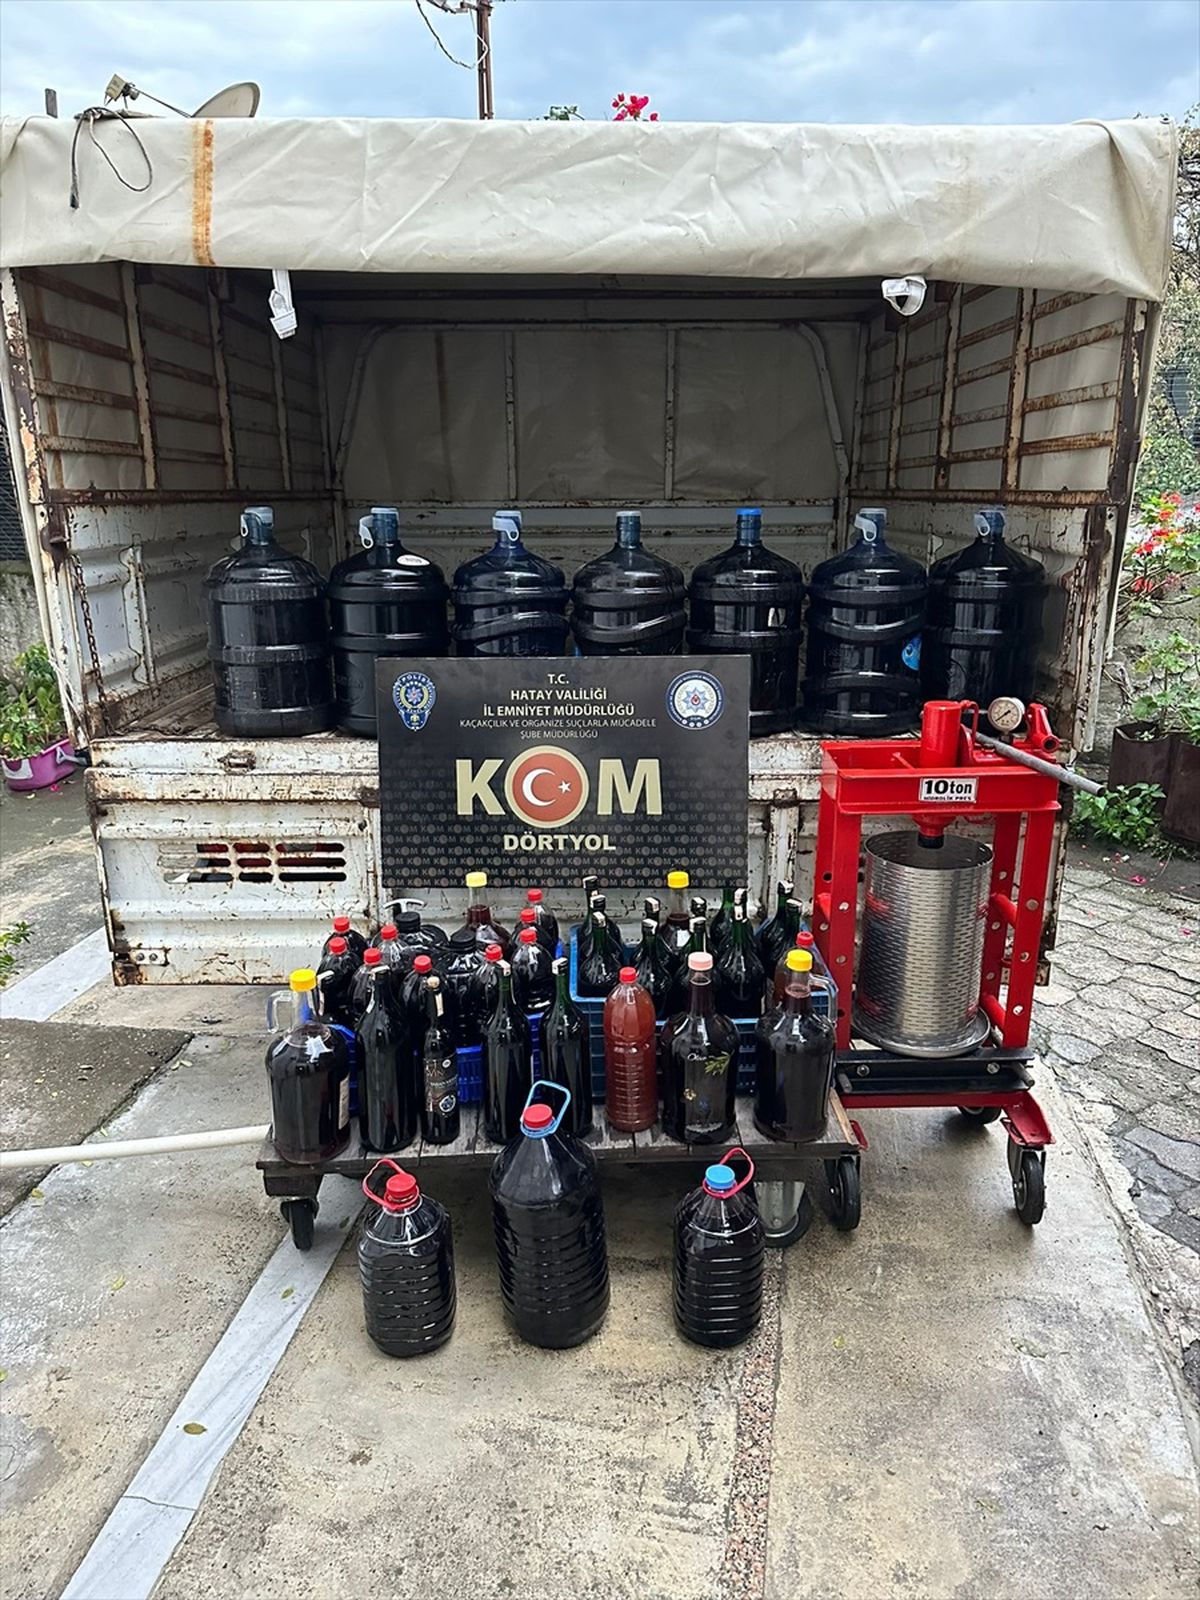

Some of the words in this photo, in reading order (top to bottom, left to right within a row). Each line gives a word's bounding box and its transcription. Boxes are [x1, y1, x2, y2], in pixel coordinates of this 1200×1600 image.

[547, 674, 570, 684] T.C.
[511, 689, 553, 700] HATAY
[555, 687, 607, 700] VALİLİĞİ
[483, 703, 495, 716] İL
[497, 703, 551, 716] EMNİYET
[553, 703, 635, 716] MÜDÜRLÜĞÜ
[459, 719, 508, 729] KAÇAKÇILIK
[509, 719, 520, 728] VE
[566, 718, 609, 729] SUÇLARLA
[503, 831, 617, 851] DÖRTYOL
